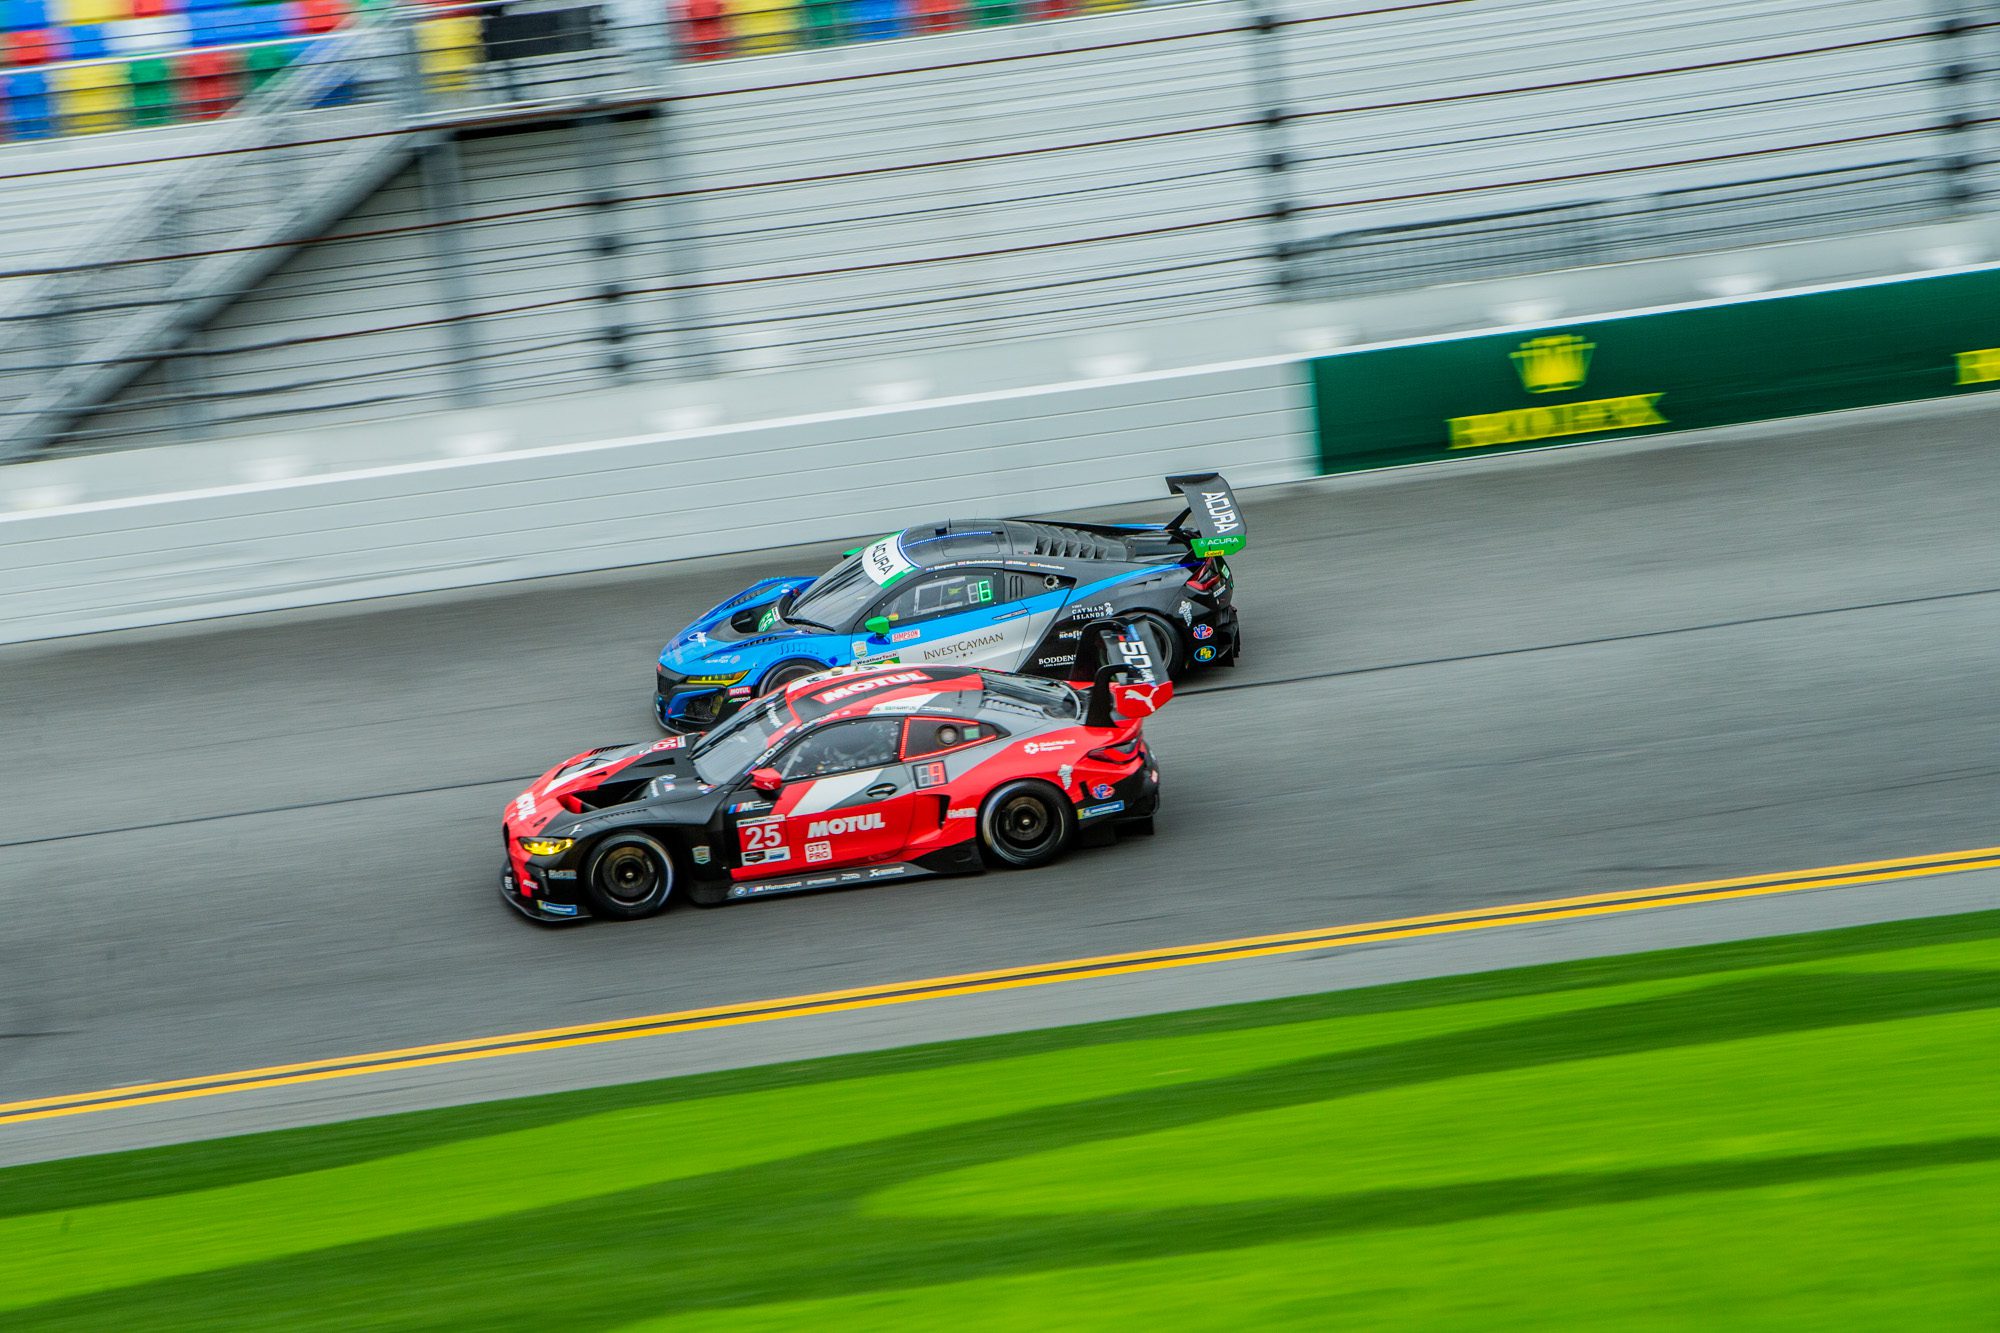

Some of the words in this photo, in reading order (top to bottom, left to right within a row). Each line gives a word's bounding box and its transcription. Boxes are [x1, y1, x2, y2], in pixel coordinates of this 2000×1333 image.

[1201, 492, 1239, 534] ACURA
[1207, 537, 1239, 546] ACURA
[872, 543, 895, 575] ACURA
[1072, 605, 1104, 615] CAYMAN
[1072, 612, 1104, 620] ISLANDS
[893, 630, 919, 642] SIMPSON
[856, 652, 897, 666] WeatherTech
[729, 687, 750, 696] MOTUL
[822, 672, 928, 702] MOTUL
[807, 812, 886, 838] MOTUL
[745, 824, 782, 850] 25
[807, 843, 828, 853] GTD
[809, 851, 829, 861] PRO
